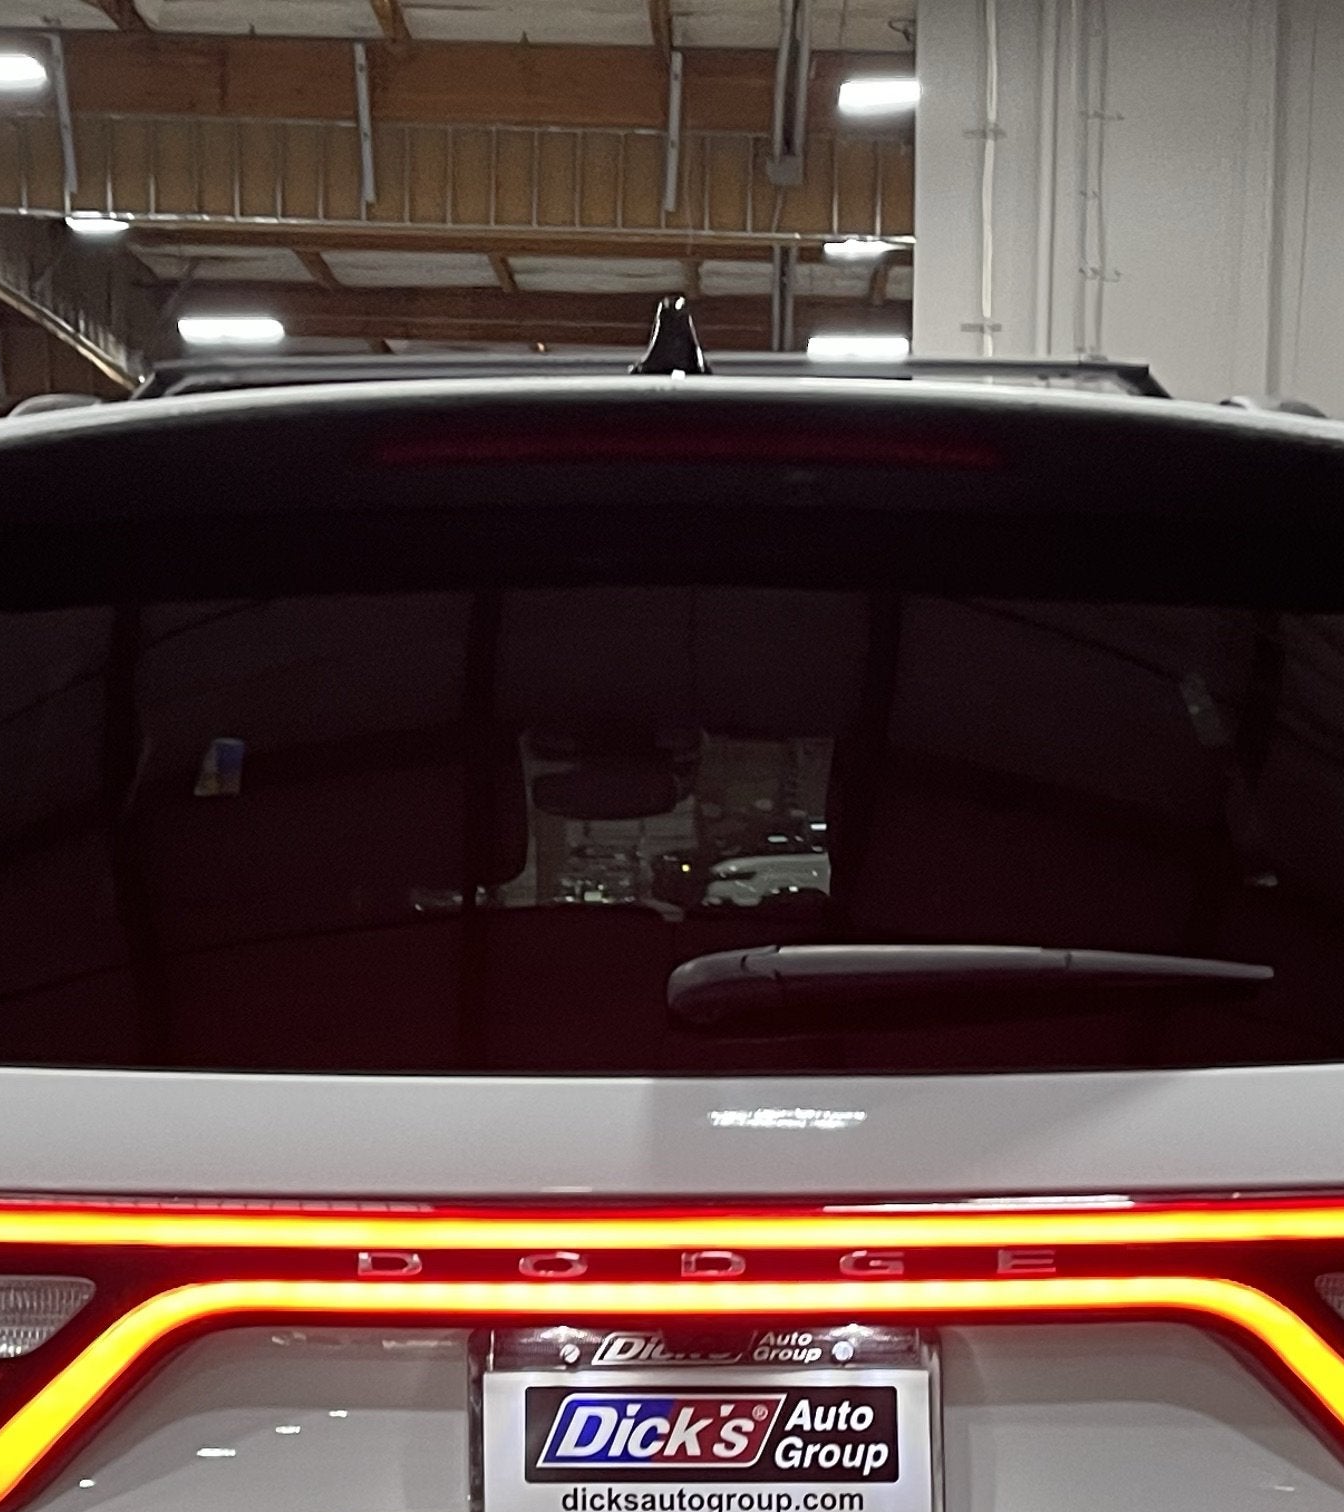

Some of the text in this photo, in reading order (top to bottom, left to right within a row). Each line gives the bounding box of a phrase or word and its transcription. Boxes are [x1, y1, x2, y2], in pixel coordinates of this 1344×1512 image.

[357, 1250, 1057, 1277] DODGE
[759, 1332, 813, 1345] Auto
[753, 1346, 822, 1363] Group
[784, 1399, 873, 1431] Auto
[774, 1437, 889, 1476] Group
